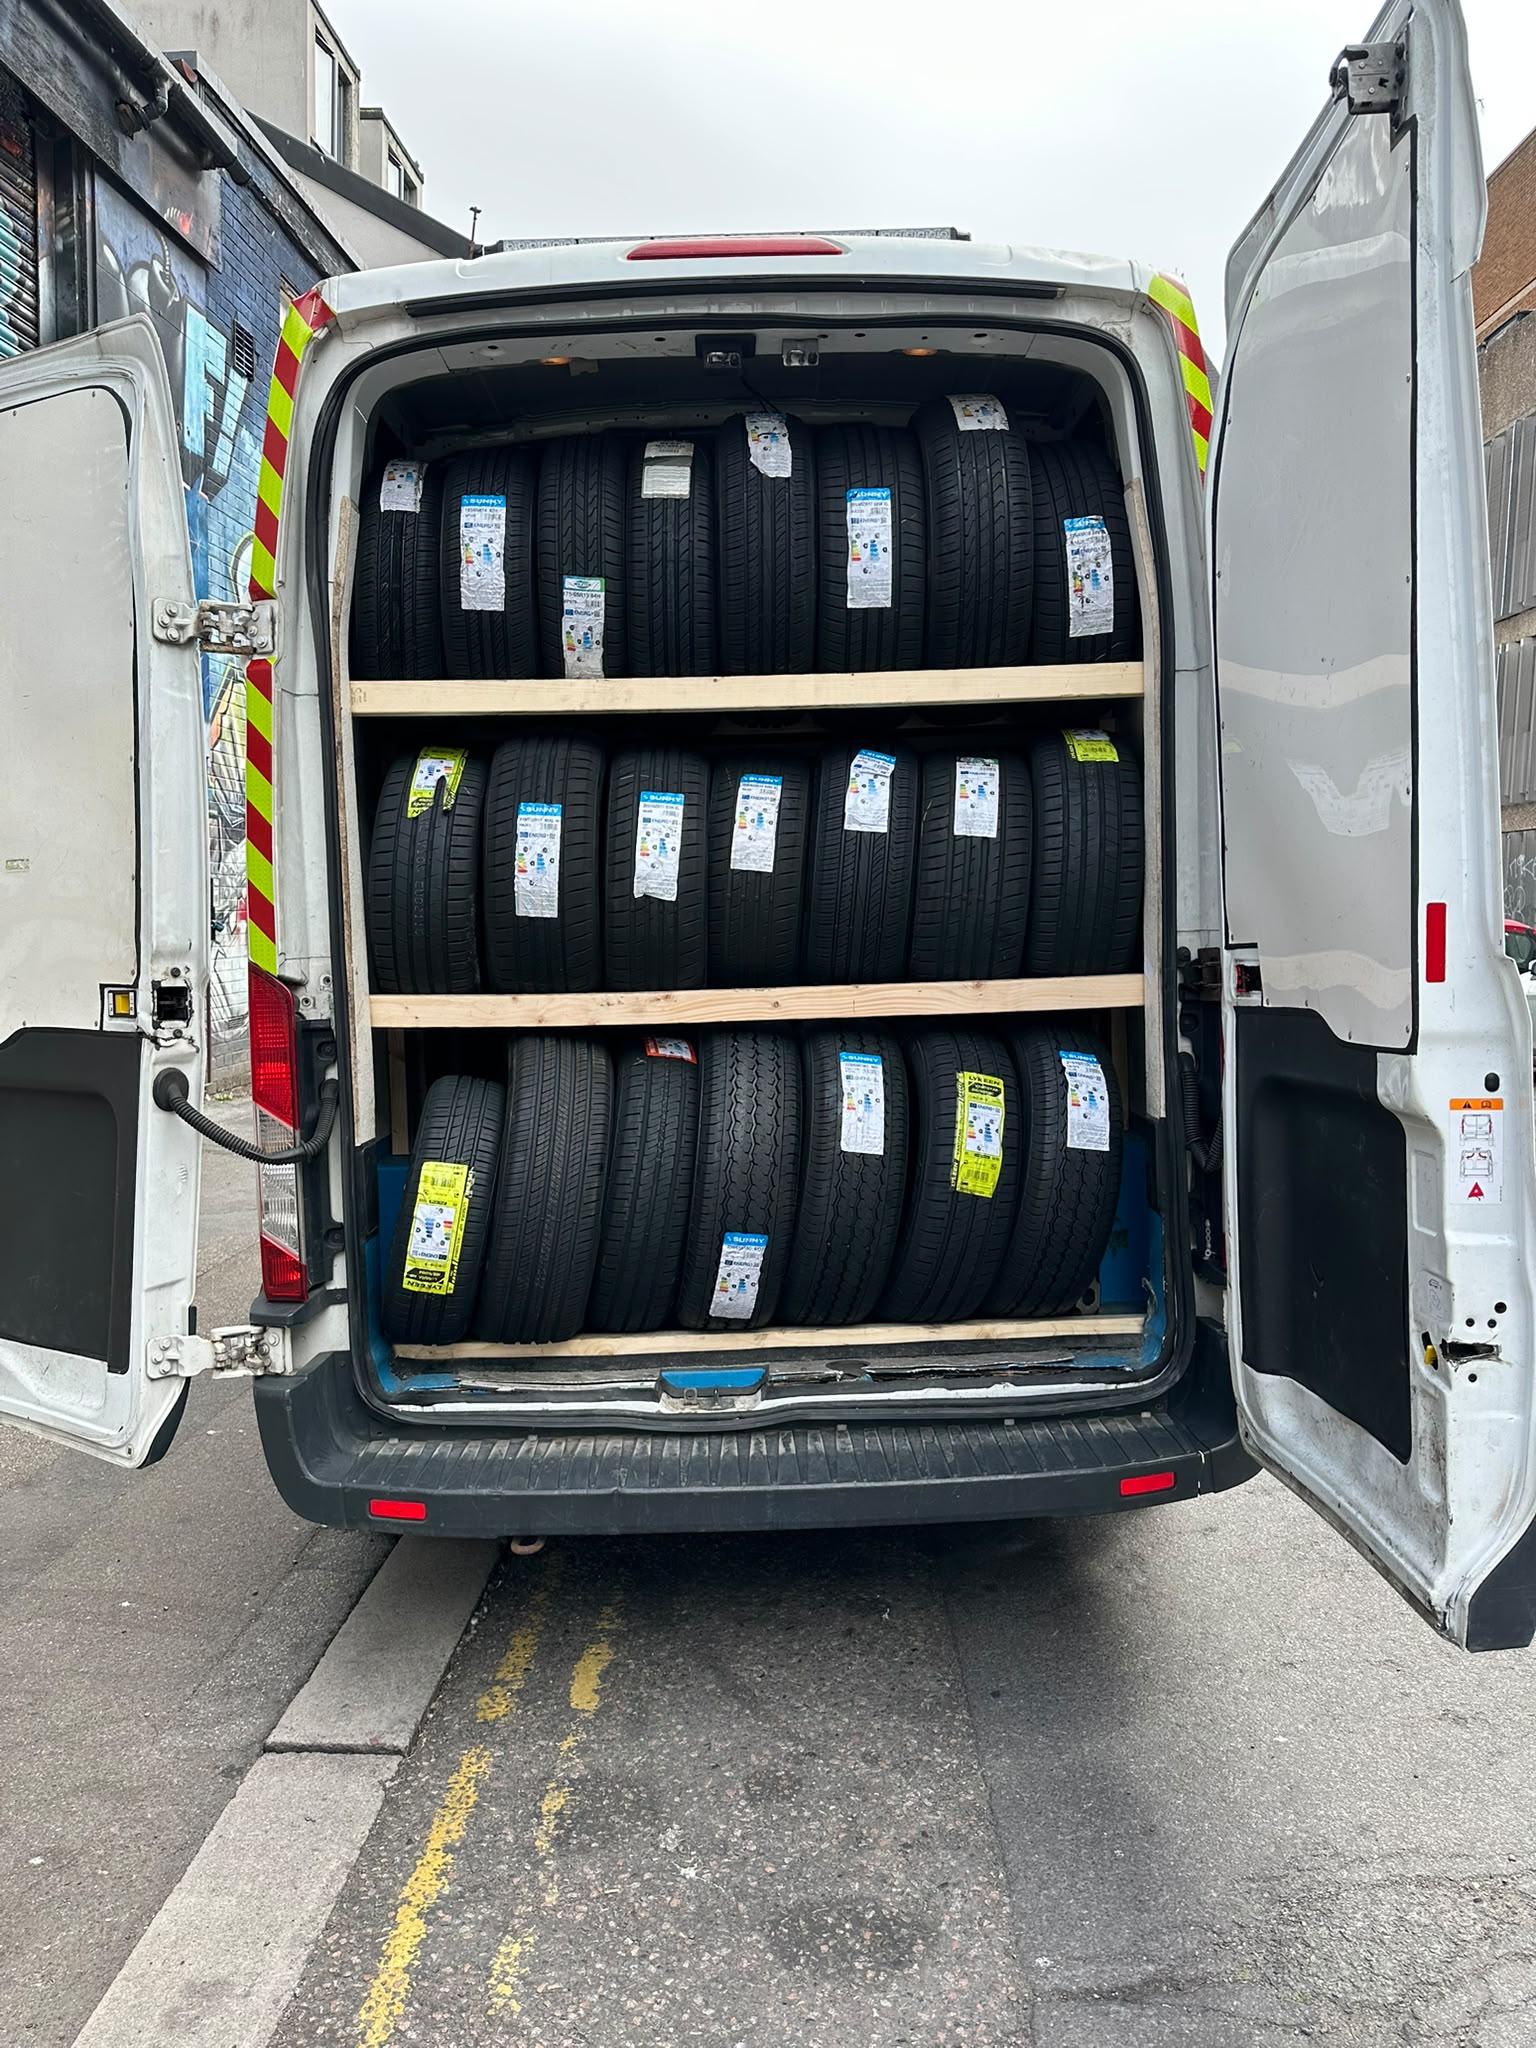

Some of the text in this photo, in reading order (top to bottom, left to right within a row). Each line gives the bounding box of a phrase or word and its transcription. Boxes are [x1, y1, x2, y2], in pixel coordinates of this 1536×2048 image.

[649, 794, 681, 802] SUNNY
[968, 1075, 1000, 1086] LYKEEN
[732, 1236, 765, 1244] SUNNY
[407, 1280, 443, 1290] LYKEEN
